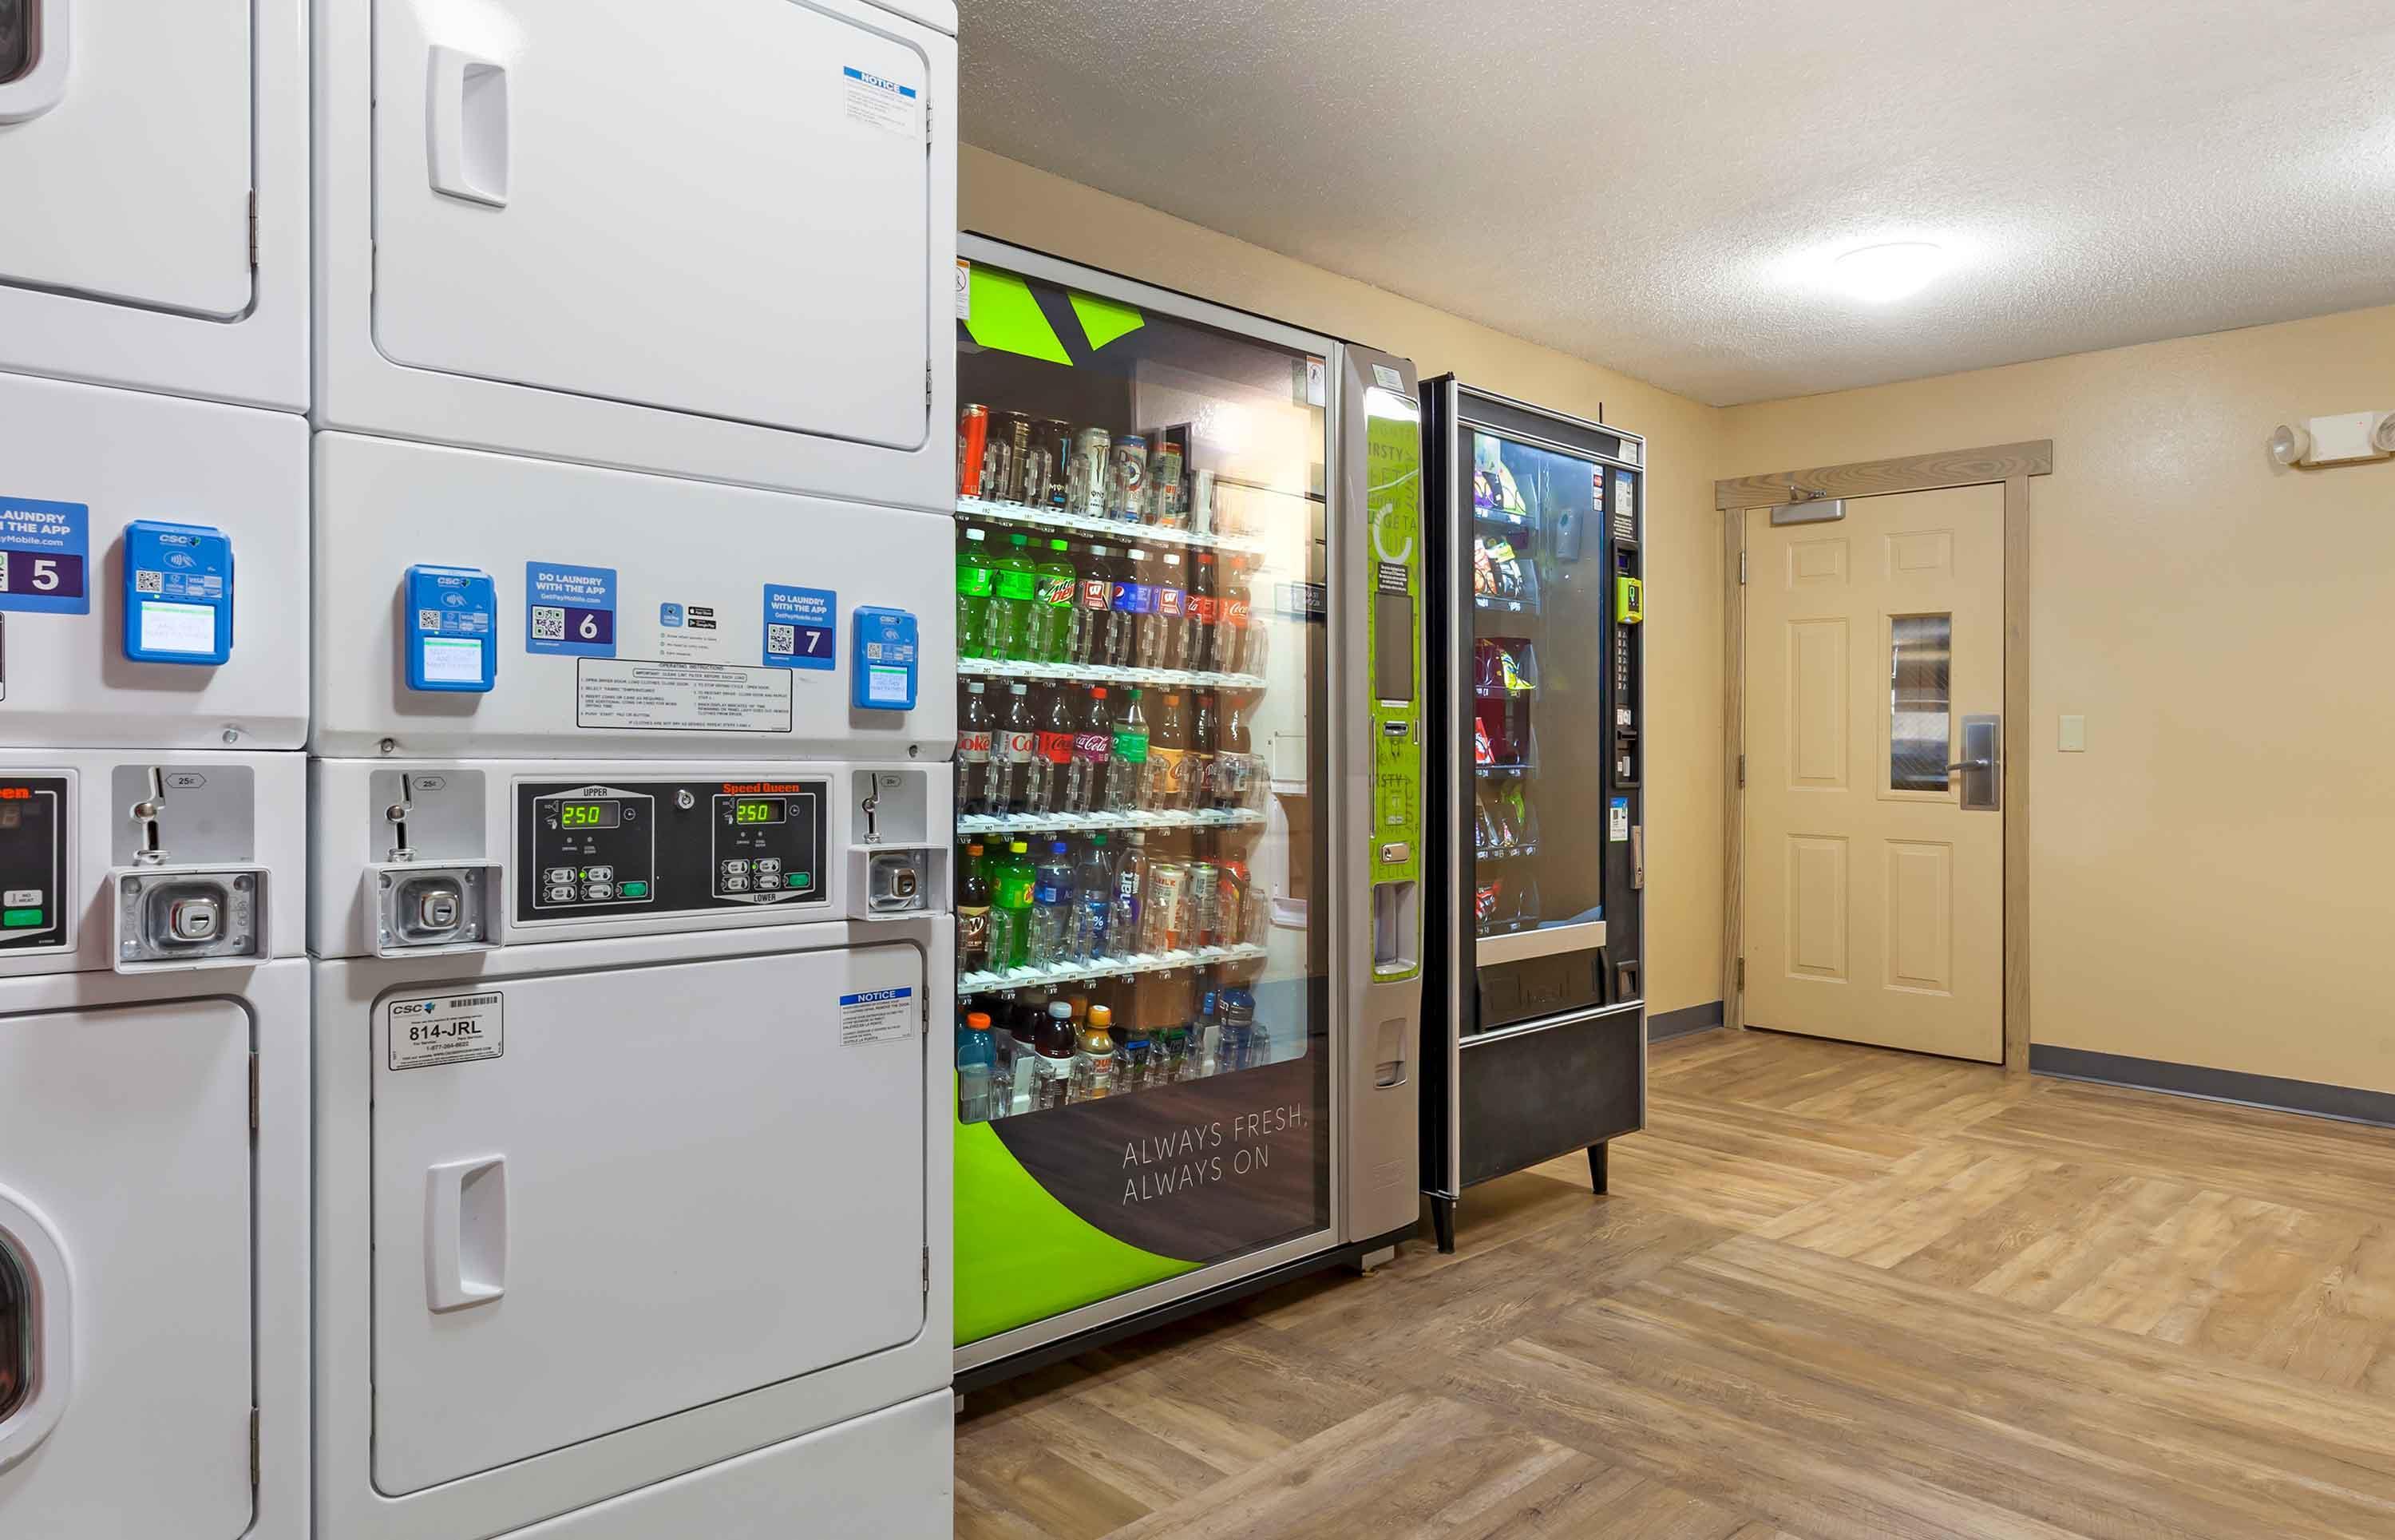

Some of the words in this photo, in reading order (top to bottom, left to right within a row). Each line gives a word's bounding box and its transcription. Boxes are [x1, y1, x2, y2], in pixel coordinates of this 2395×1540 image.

[861, 72, 901, 93] NOTICE
[8, 521, 38, 533] THE
[41, 525, 71, 535] APP
[0, 536, 64, 546] yMobile.com
[160, 534, 188, 543] CSC
[32, 559, 60, 591] 5
[539, 572, 554, 581] DO
[556, 574, 602, 586] LAUNDRY
[536, 582, 563, 591] WITH
[564, 584, 584, 593] THE
[586, 586, 606, 595] APP
[771, 602, 794, 612] WITH
[794, 604, 810, 613] THE
[788, 596, 825, 606] LAUNDRY
[580, 613, 598, 639] 6
[806, 631, 821, 653] 7
[584, 788, 608, 797] UPPER
[722, 783, 761, 795] Speed
[762, 782, 800, 793] Queen
[563, 806, 600, 824] 250
[738, 805, 768, 821] 250
[857, 991, 896, 1002] NOTICE
[393, 1004, 422, 1015] CSC
[410, 1021, 482, 1040] 814-JRL
[1122, 1122, 1221, 1169] ALWAYS
[1122, 1156, 1222, 1205] ALWAYS
[1233, 1144, 1269, 1174] ON
